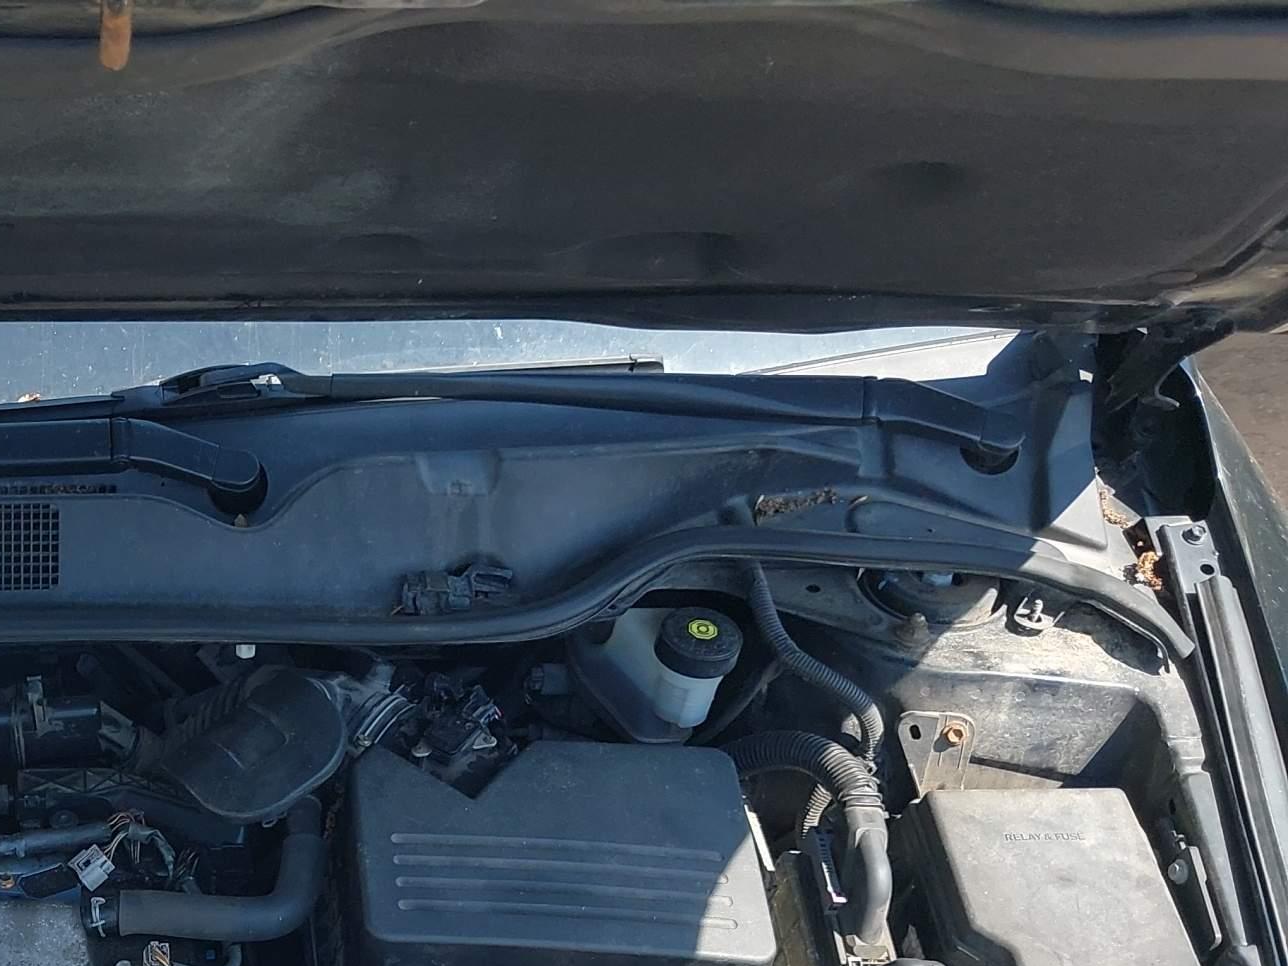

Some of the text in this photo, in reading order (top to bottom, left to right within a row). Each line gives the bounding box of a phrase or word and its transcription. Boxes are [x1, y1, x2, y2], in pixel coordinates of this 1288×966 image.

[1003, 832, 1086, 842] RELAY & FUSE
